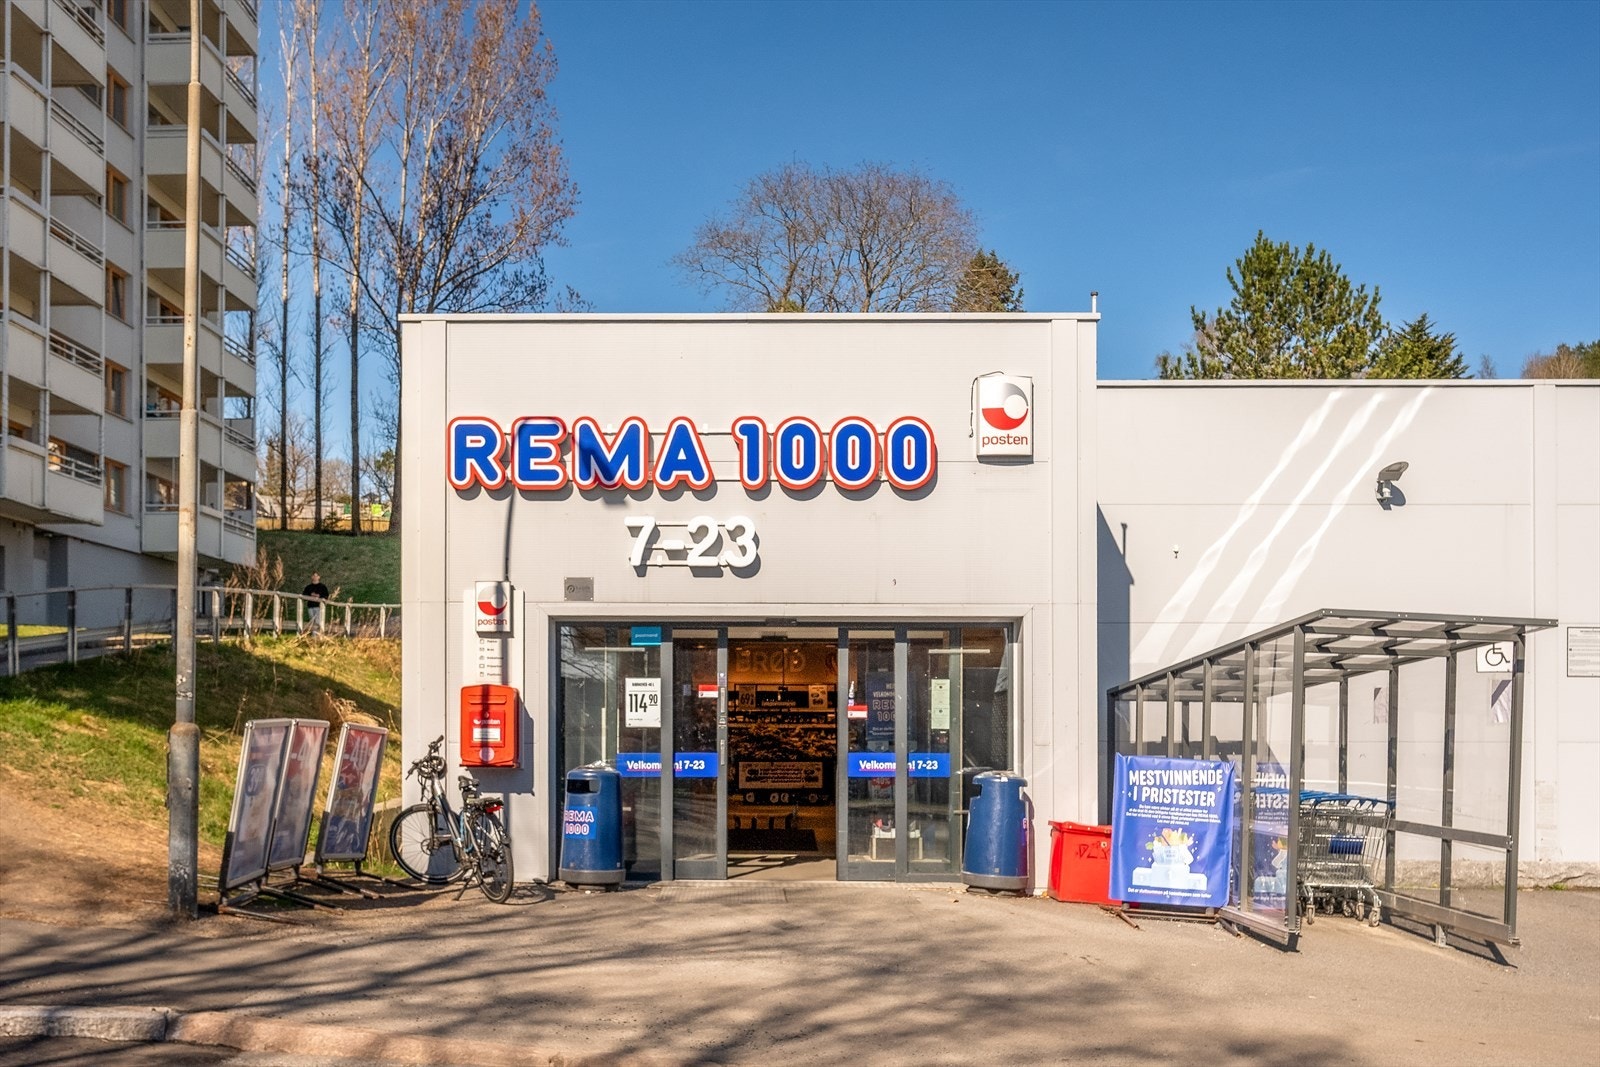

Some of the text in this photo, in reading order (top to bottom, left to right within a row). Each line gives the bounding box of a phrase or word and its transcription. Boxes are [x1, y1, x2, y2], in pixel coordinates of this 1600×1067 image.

[982, 434, 1028, 447] posten
[447, 416, 935, 490] REMA 1000
[478, 618, 508, 627] posten
[629, 693, 658, 713] 114 90
[626, 760, 705, 770] Velkomn! 7-23
[859, 760, 939, 770] Velkomn! 7-23
[1129, 769, 1224, 786] MESTVINNENDE
[1133, 786, 1216, 808] I PRISTESTER
